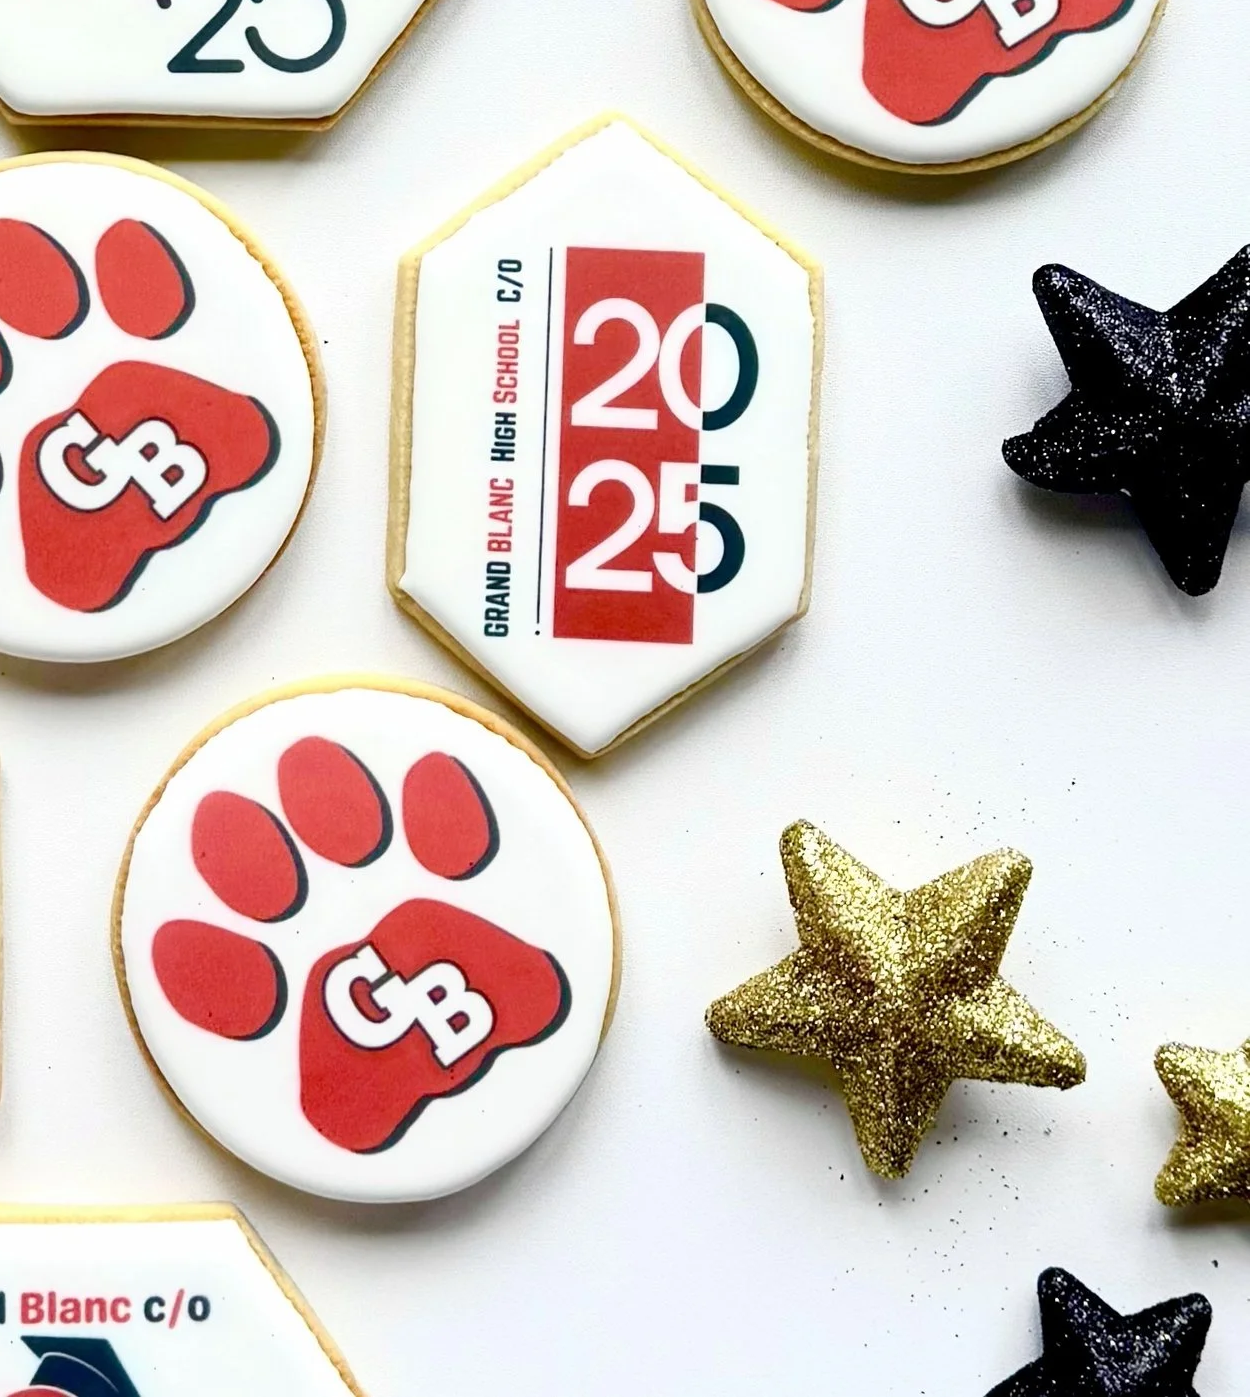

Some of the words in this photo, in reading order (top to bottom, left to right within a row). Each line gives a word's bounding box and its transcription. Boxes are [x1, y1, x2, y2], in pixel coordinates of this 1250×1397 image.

[496, 258, 524, 303] C/O
[492, 319, 521, 404] SCHOOL
[36, 409, 209, 522] GB
[489, 411, 517, 463] HIGH
[486, 477, 515, 553] BLANC
[483, 560, 512, 638] GRAND
[322, 940, 497, 1069] GB
[19, 1290, 132, 1325] Blanc
[143, 1288, 212, 1329] c/o
